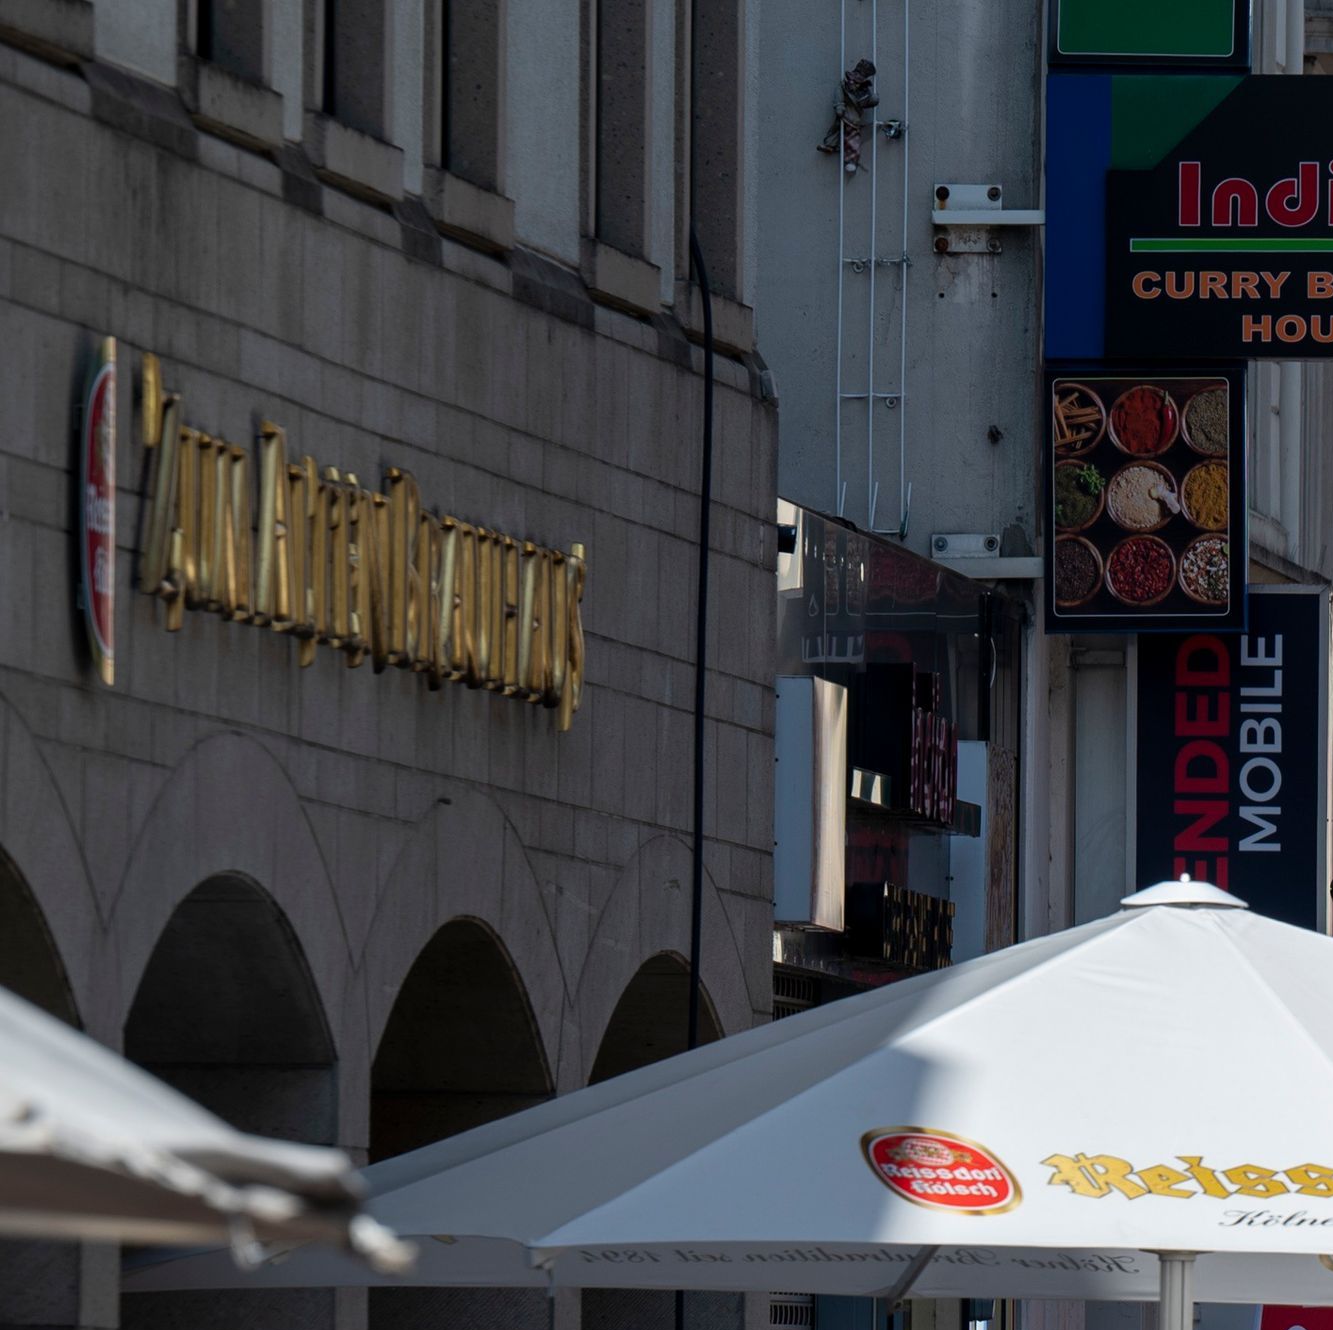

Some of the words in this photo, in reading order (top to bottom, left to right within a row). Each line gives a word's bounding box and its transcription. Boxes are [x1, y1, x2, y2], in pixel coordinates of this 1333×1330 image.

[1132, 271, 1290, 300] CURRY
[1239, 634, 1283, 852] MOBILE
[880, 1162, 1003, 1181] Reissdorf
